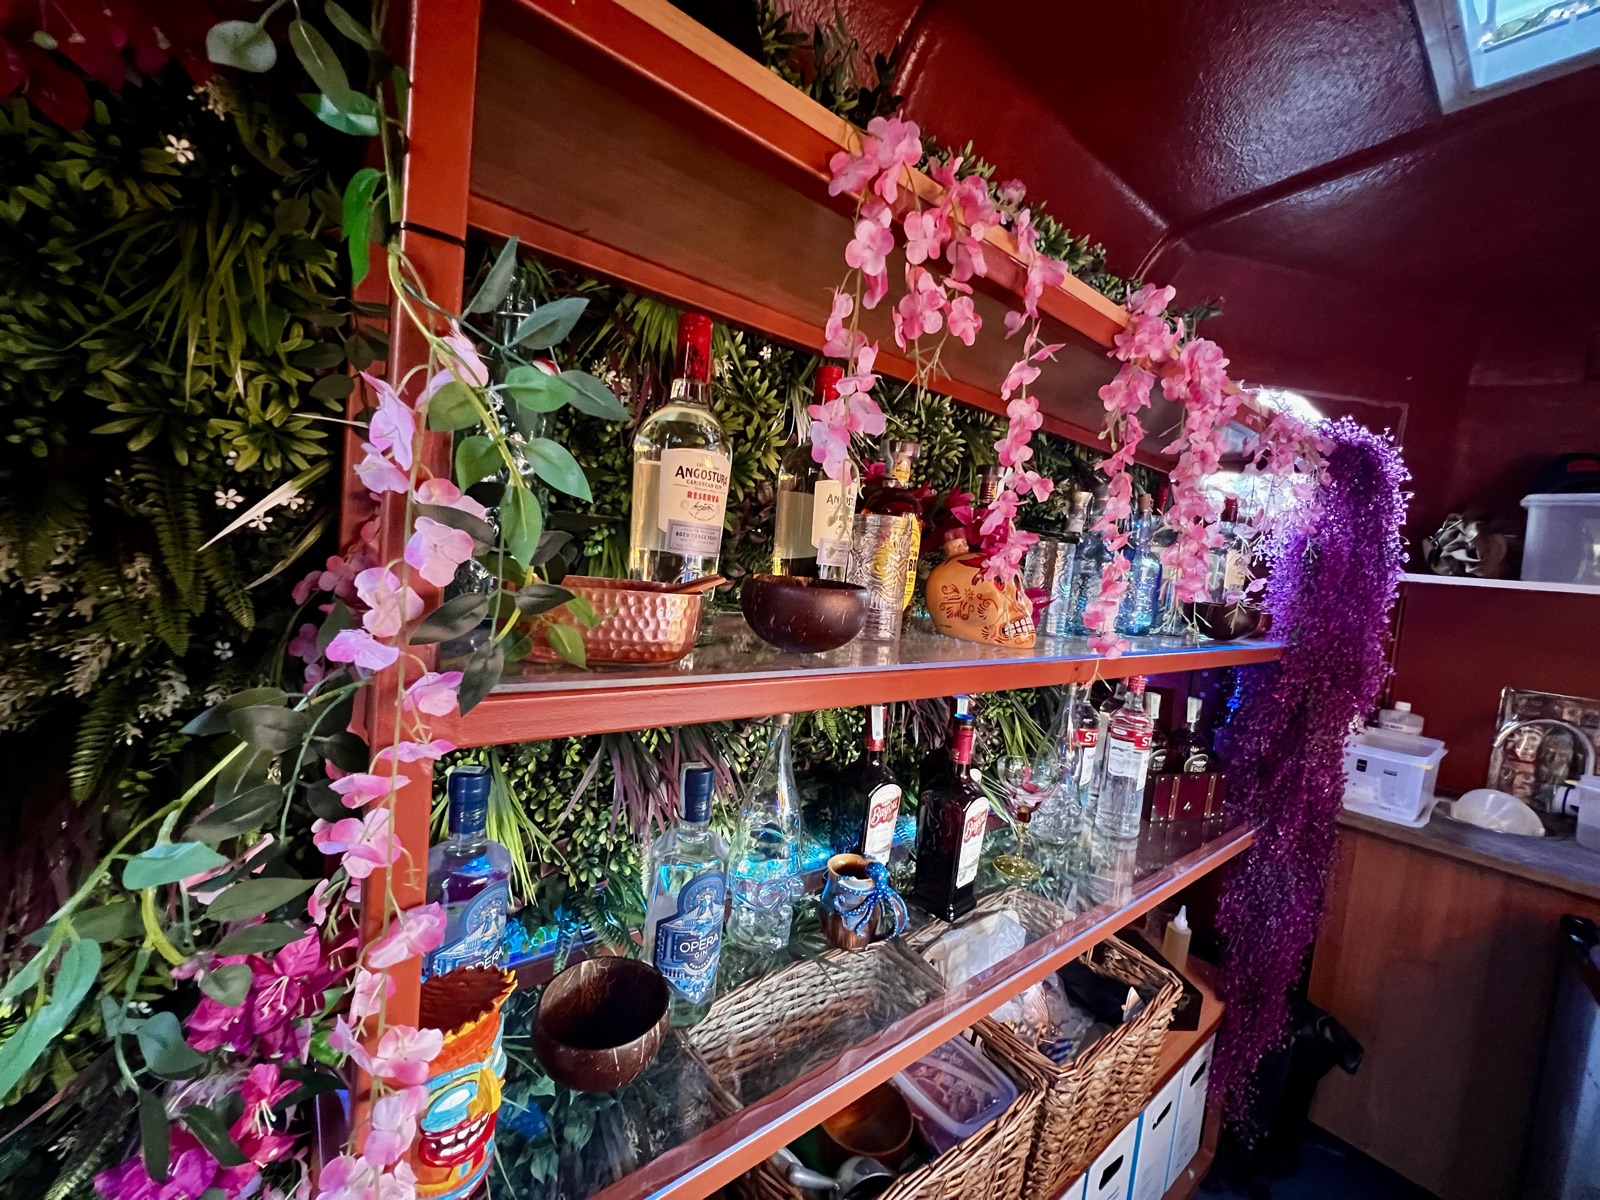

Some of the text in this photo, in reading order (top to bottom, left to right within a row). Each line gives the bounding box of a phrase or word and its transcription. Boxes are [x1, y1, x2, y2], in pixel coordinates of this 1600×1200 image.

[686, 490, 719, 504] RESERVA
[680, 931, 719, 953] OPERA
[694, 949, 708, 959] GIN
